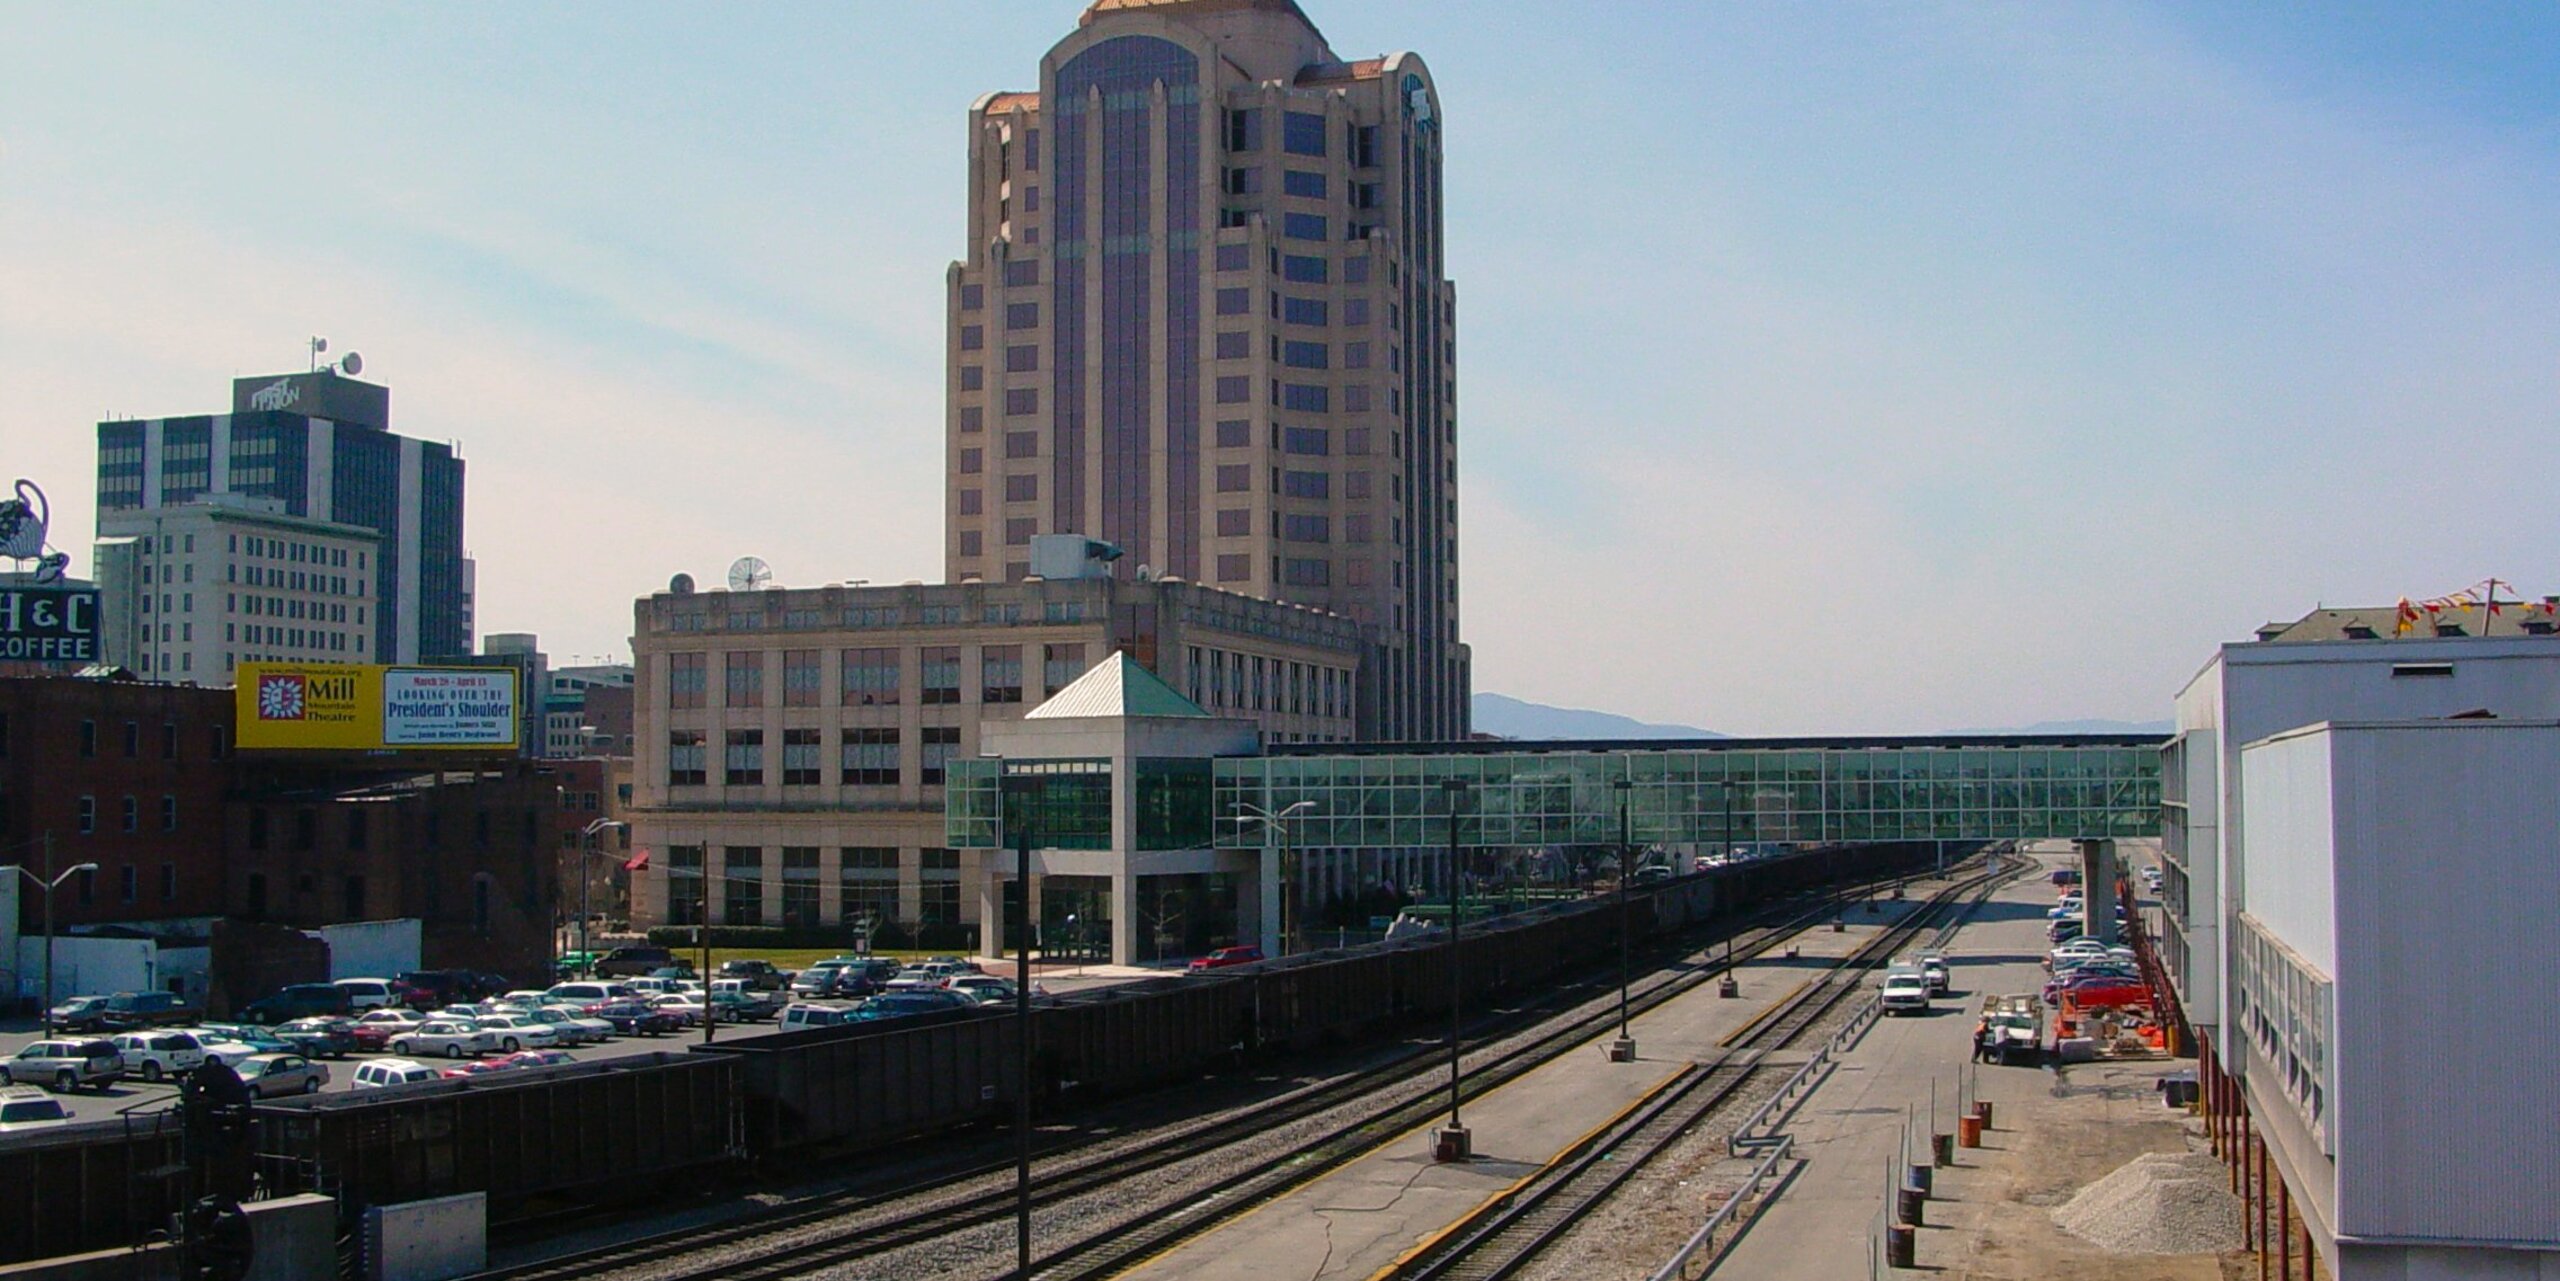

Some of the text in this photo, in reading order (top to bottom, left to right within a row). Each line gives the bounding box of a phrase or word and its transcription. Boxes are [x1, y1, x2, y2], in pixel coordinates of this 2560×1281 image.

[309, 678, 355, 700] Mill
[398, 690, 502, 700] LOOKING OVER THE
[308, 702, 355, 710] Mountain
[388, 702, 511, 718] President's Shoulder
[308, 711, 356, 721] Theatre
